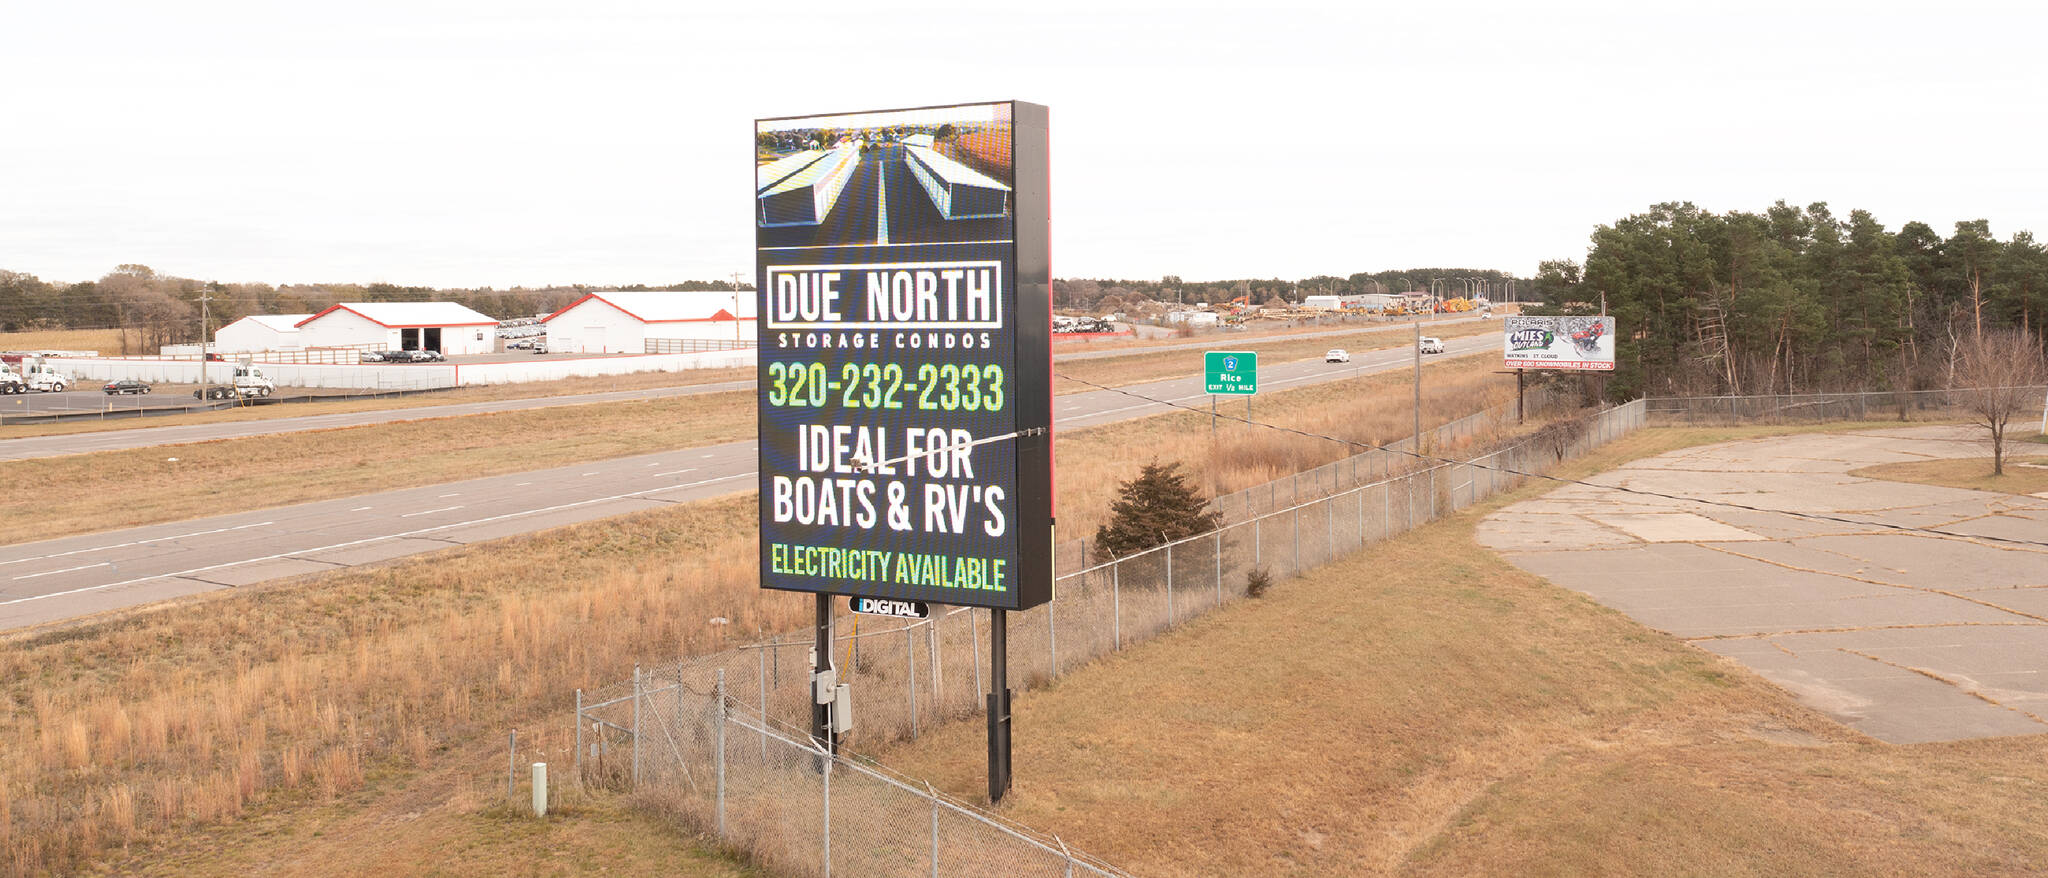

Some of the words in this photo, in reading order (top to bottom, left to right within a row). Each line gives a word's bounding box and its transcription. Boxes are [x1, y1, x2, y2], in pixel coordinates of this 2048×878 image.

[778, 272, 841, 321] DUE
[867, 269, 990, 321] NORTH
[778, 333, 879, 348] STORAGE
[895, 333, 991, 348] CONDOS
[1513, 330, 1544, 341] MIES
[768, 362, 1004, 411] 320-232-2333
[1220, 374, 1242, 382] Rice
[1228, 361, 1234, 369] 2
[799, 424, 896, 475] IDEAL
[906, 427, 974, 479] FOR
[773, 475, 877, 529] BOATS
[887, 480, 913, 531] &
[924, 483, 1006, 537] RV'S
[771, 543, 892, 582] ELECTRICITY
[895, 552, 1007, 592] AVAILABLE
